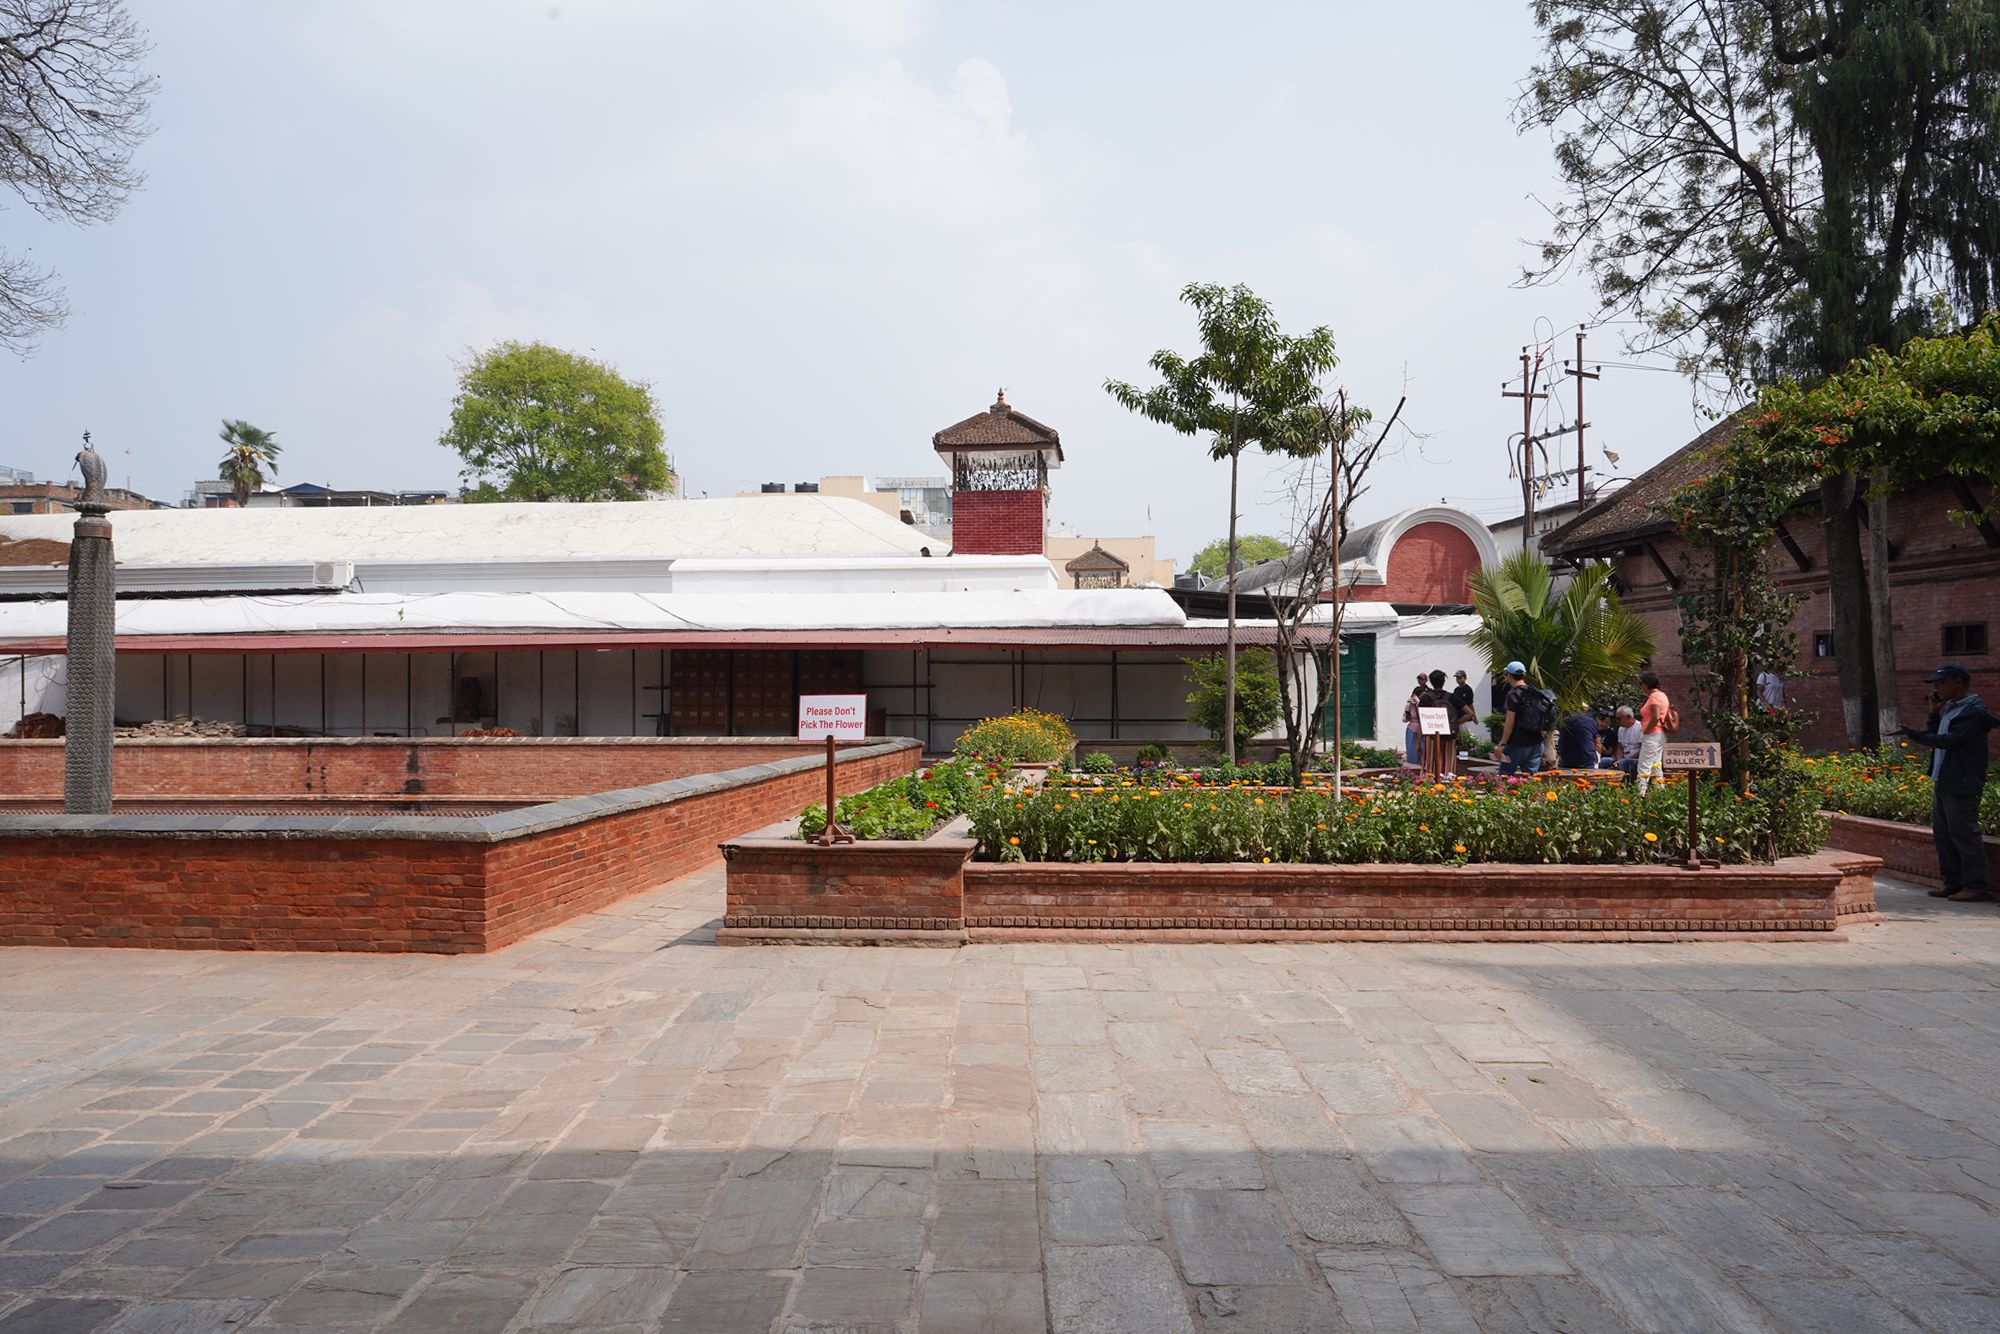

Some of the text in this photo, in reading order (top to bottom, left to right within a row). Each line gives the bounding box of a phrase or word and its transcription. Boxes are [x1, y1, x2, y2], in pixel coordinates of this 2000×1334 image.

[806, 706, 856, 716] Please Don't
[800, 720, 863, 729] Pick The Flower
